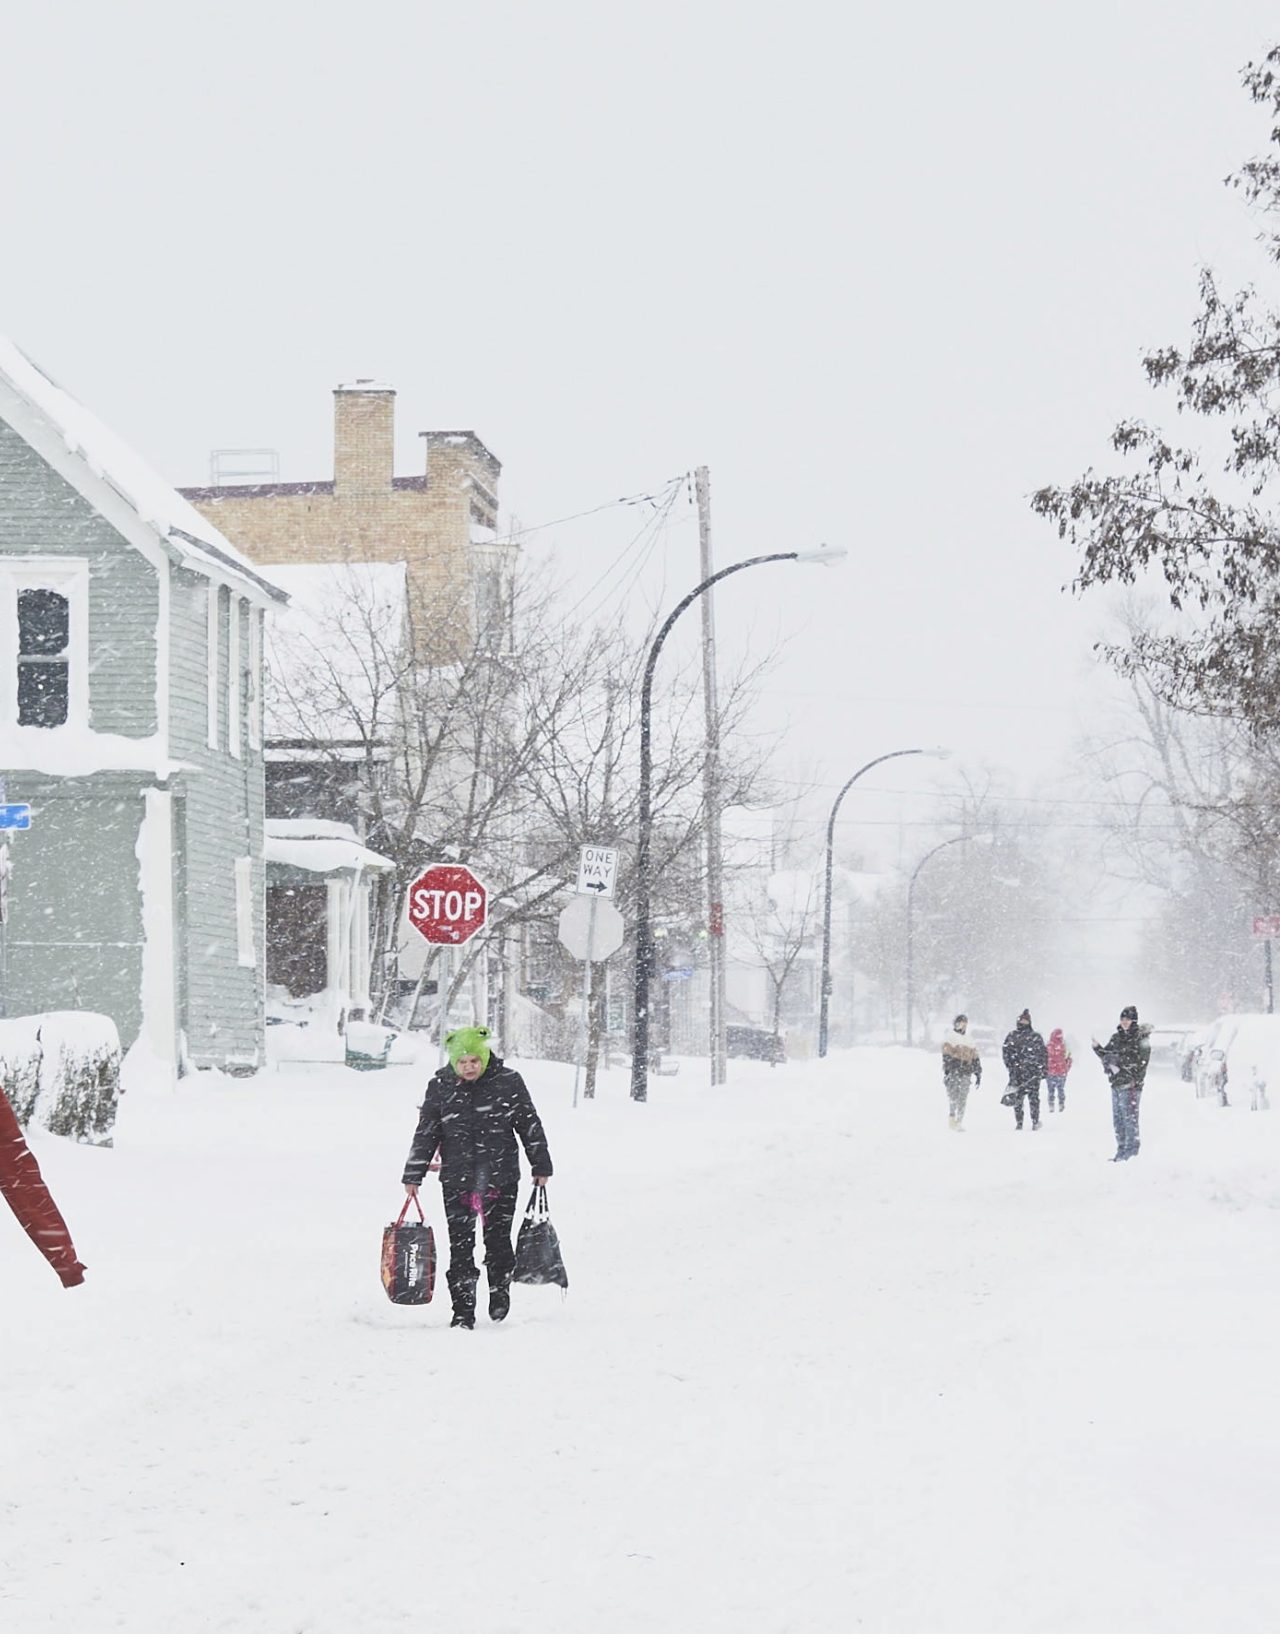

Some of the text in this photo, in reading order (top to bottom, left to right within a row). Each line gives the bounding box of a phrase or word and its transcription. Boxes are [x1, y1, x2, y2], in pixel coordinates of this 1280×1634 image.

[585, 849, 613, 864] ONE
[583, 863, 612, 878] WAY
[412, 889, 482, 922] STOP
